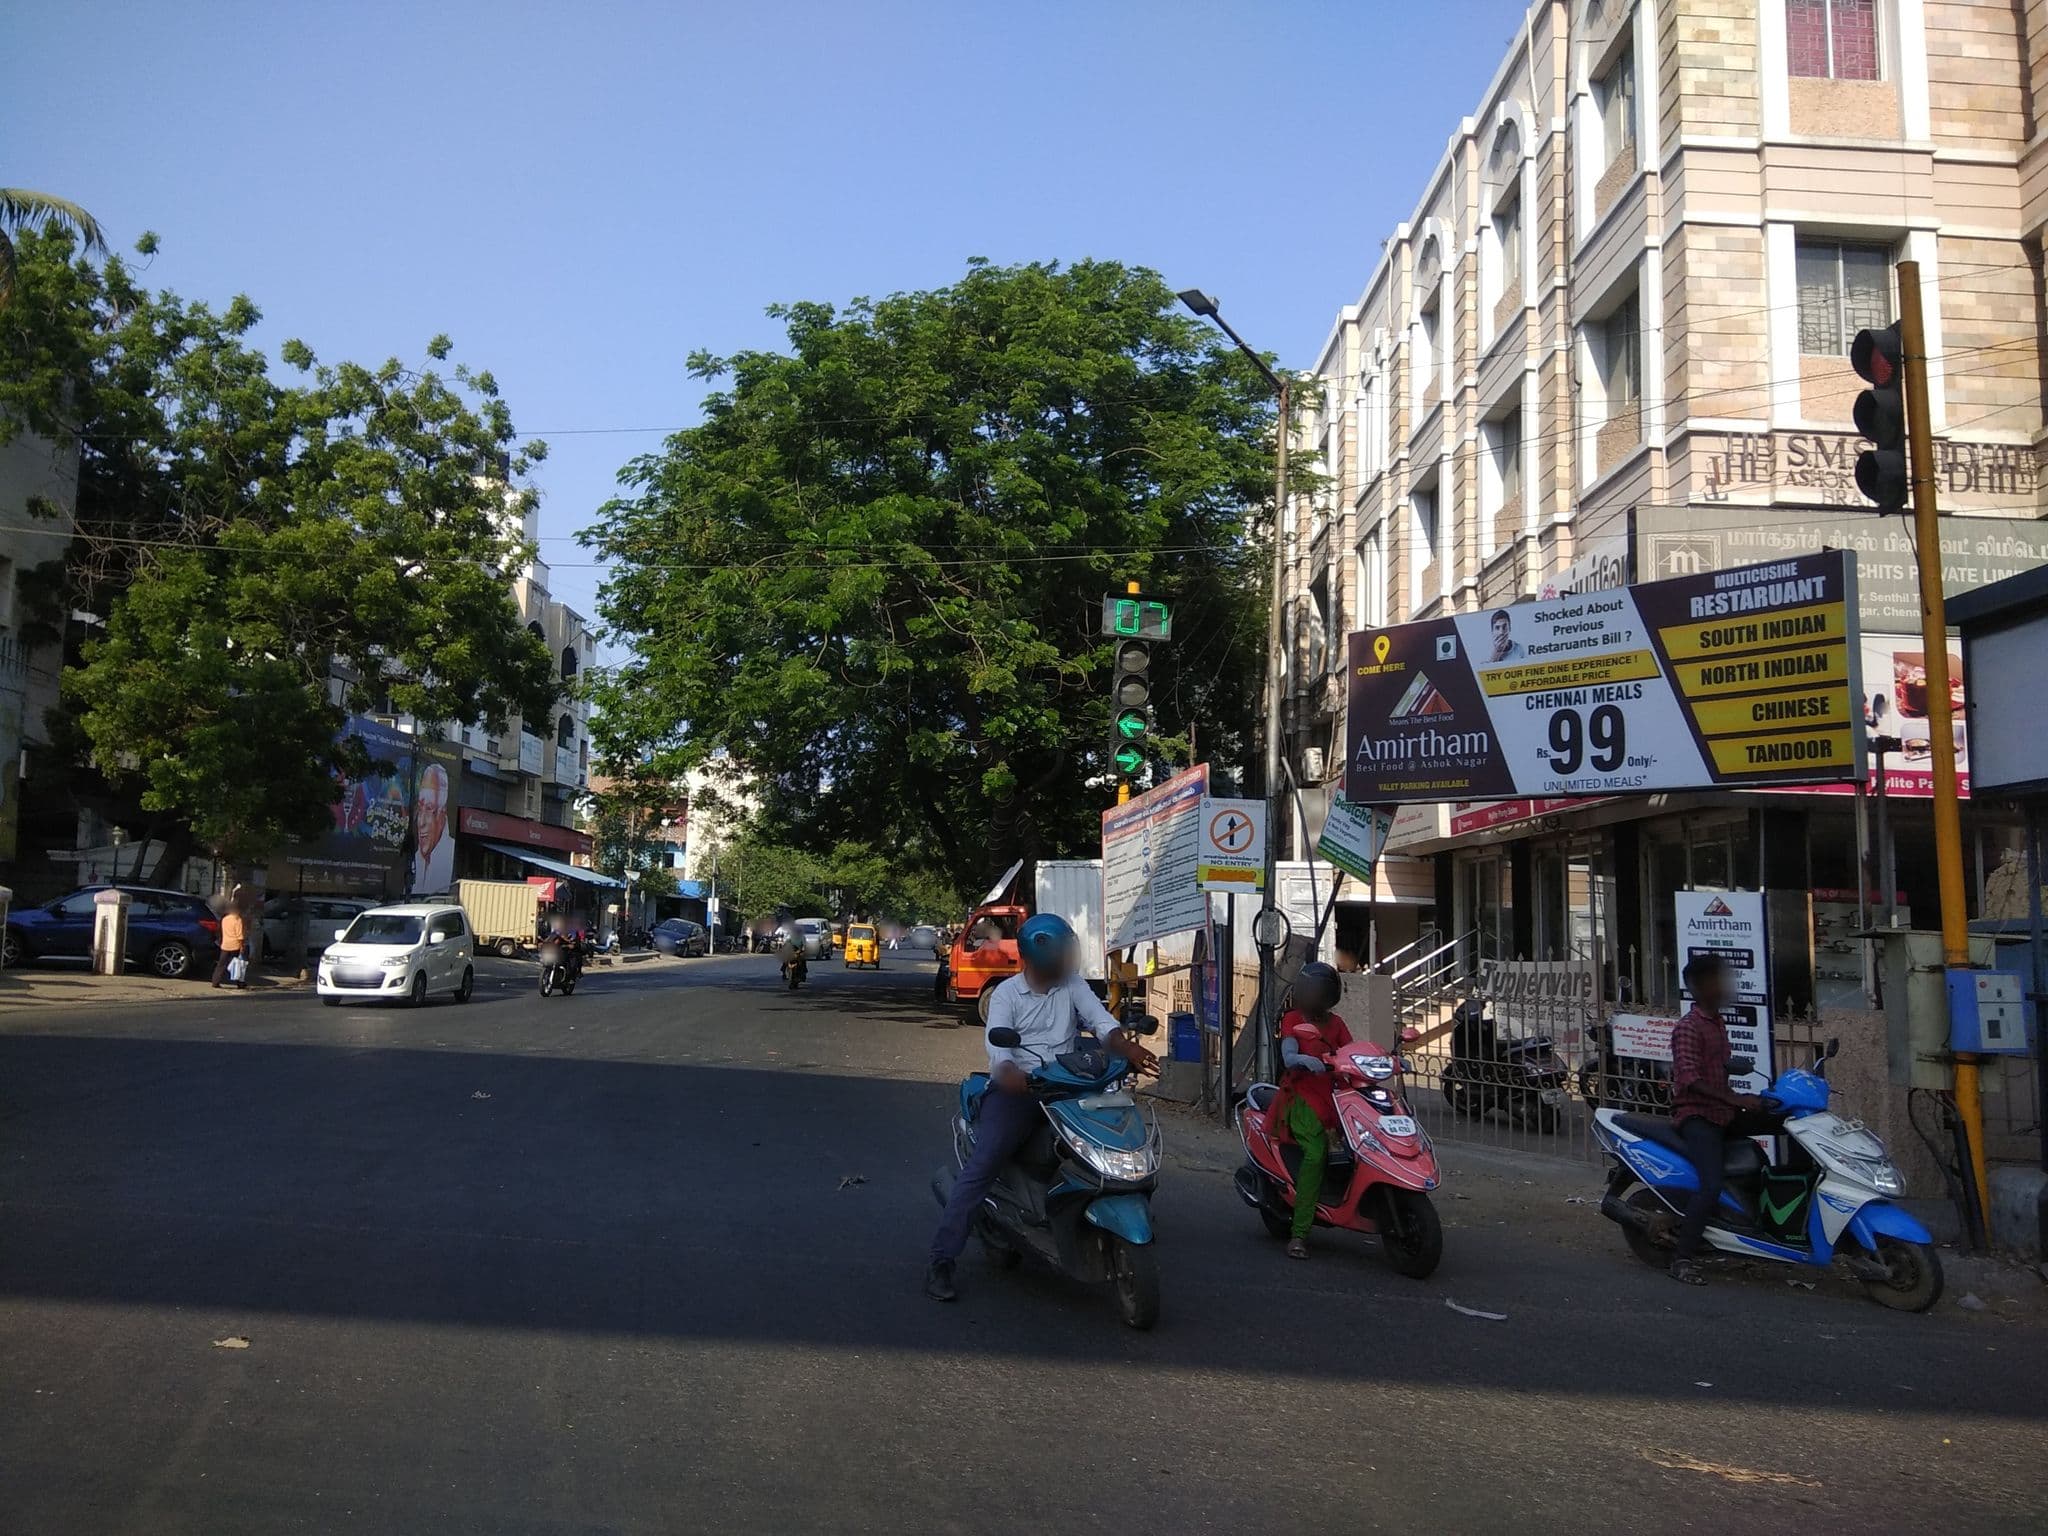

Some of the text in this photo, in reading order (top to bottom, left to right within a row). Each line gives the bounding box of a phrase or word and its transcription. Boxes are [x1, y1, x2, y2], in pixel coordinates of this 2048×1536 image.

[1714, 562, 1798, 589] MULTICUSINE
[1857, 564, 1903, 580] CHITS
[1689, 576, 1826, 618] RESTARUANT
[1870, 591, 1909, 602] Senthil
[1116, 600, 1168, 635] 07
[1534, 599, 1623, 623] Shocked About
[1553, 619, 1605, 636] Previous
[1700, 614, 1826, 649] SOUTH INDIAN
[1528, 636, 1599, 656] Restaruants
[1602, 632, 1621, 645] Bill
[1357, 662, 1406, 676] COME HERE
[1486, 672, 1503, 682] TRY
[1504, 669, 1523, 680] OUR
[1525, 666, 1545, 677] FINE
[1548, 663, 1570, 674] DINE
[1572, 657, 1632, 672] EXPERIENCE
[1520, 674, 1579, 689] AFFORDABLE
[1582, 670, 1611, 681] PRICE
[1701, 653, 1828, 686] NORTH INDIAN
[1526, 683, 1643, 710] CHENNAI MEALS
[1752, 696, 1830, 722] CHINESE
[1355, 729, 1488, 761] Amirtham
[1536, 747, 1552, 759] Rs.
[1548, 704, 1625, 775] 99
[1746, 739, 1832, 763] TANDOOR
[1356, 762, 1377, 772] Best
[1381, 760, 1403, 771] Food
[1421, 756, 1452, 769] Ashok
[1456, 755, 1487, 768] Nagar
[1378, 778, 1469, 792] VALET PARKING AVAILABLE
[1543, 779, 1601, 792] UNLIMITED
[1688, 918, 1752, 932] Amirtham
[1481, 961, 1593, 1002] Tupperware
